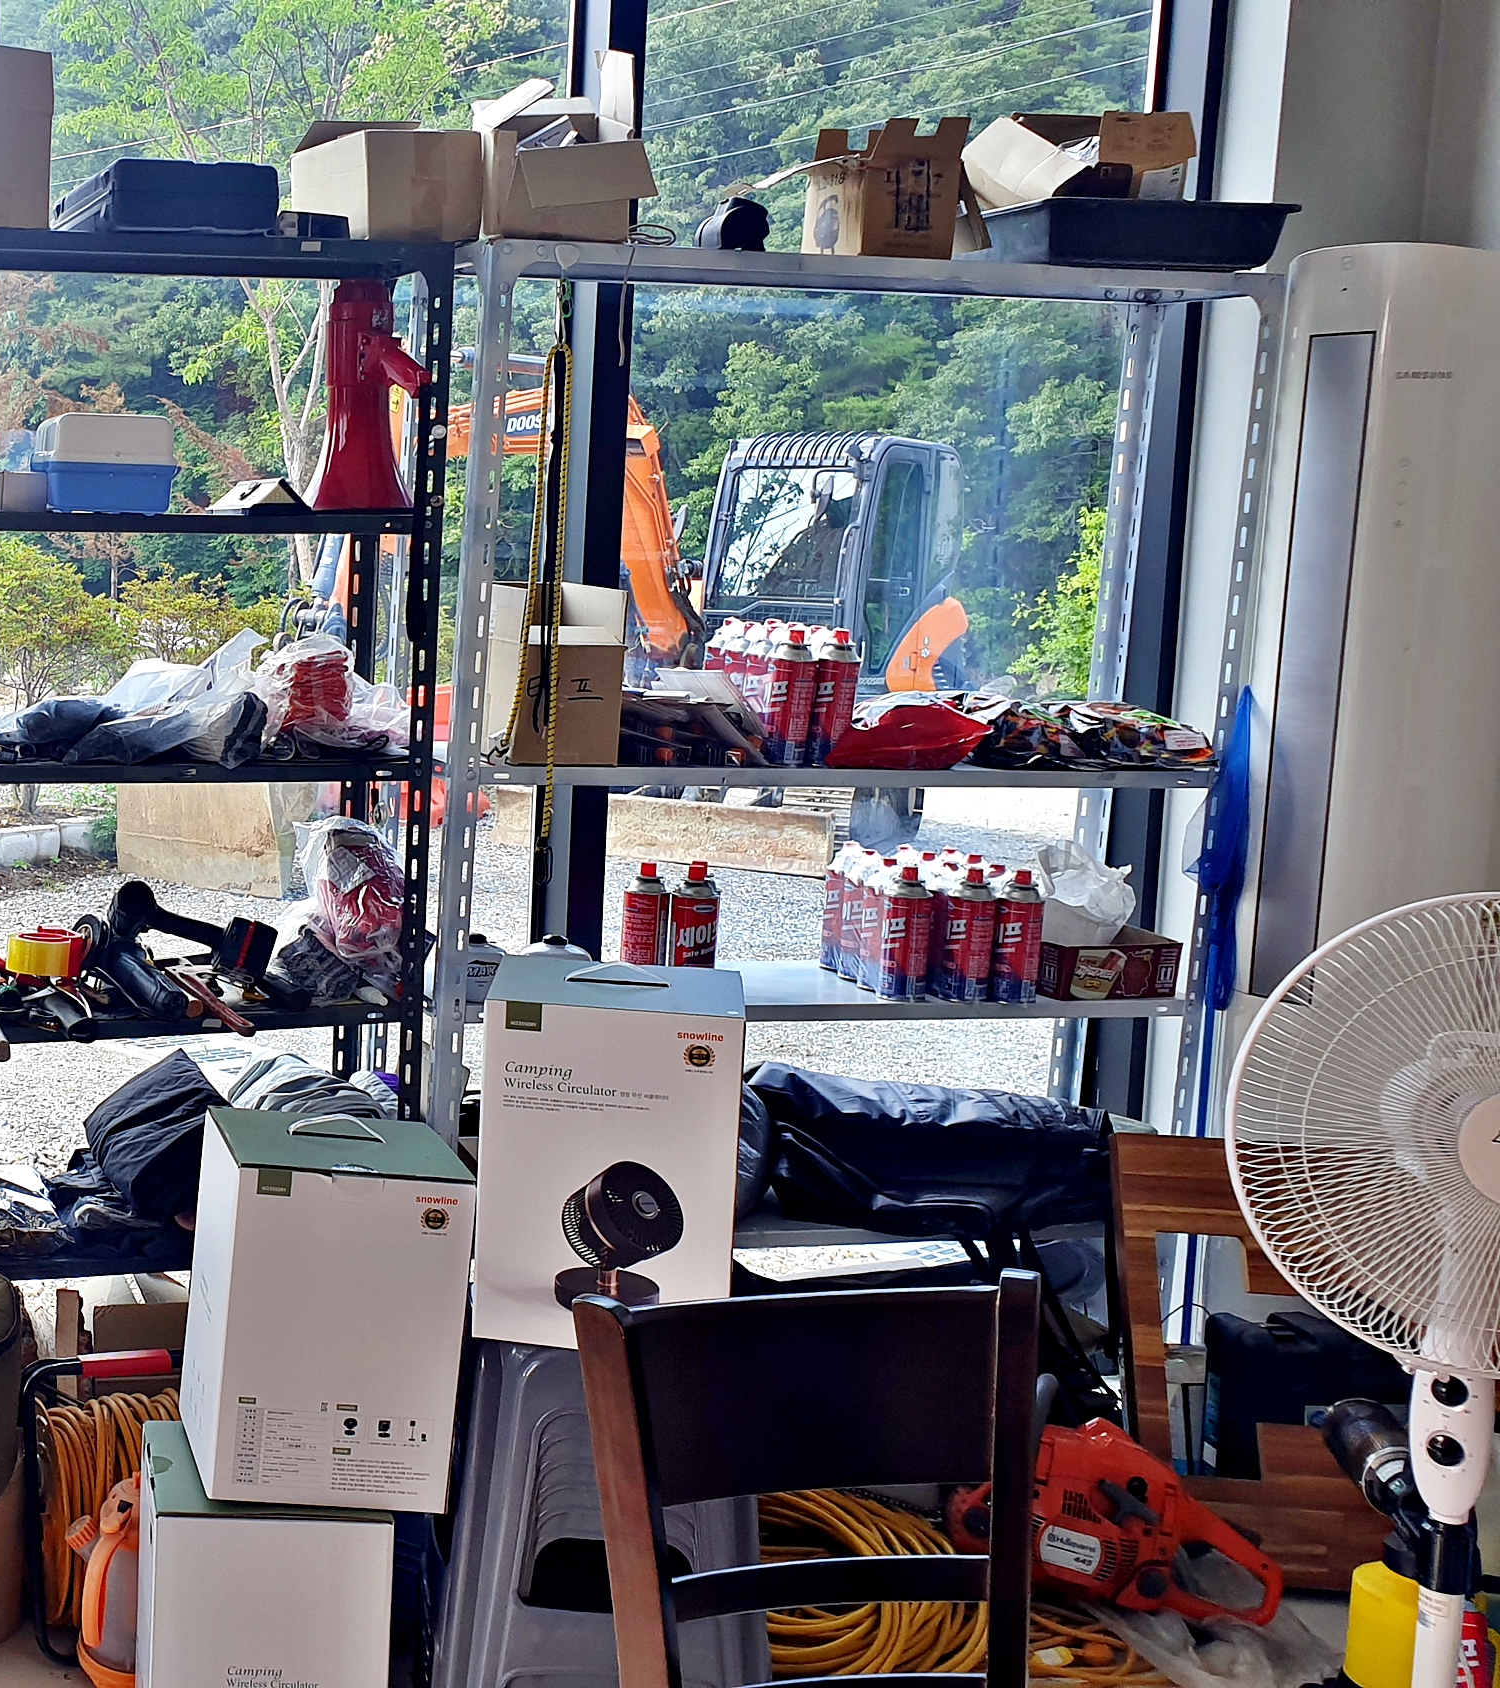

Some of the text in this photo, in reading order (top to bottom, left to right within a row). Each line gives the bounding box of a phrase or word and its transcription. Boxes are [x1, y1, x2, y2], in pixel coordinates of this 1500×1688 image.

[676, 1031, 724, 1042] snowline
[504, 1060, 573, 1082] Camping
[503, 1077, 554, 1092] Wireless
[557, 1081, 617, 1098] Circulator
[415, 1195, 459, 1206] snowline
[1073, 1556, 1093, 1567] 445
[227, 1665, 283, 1680] Camping
[226, 1678, 319, 1688] Wireless Circulator
